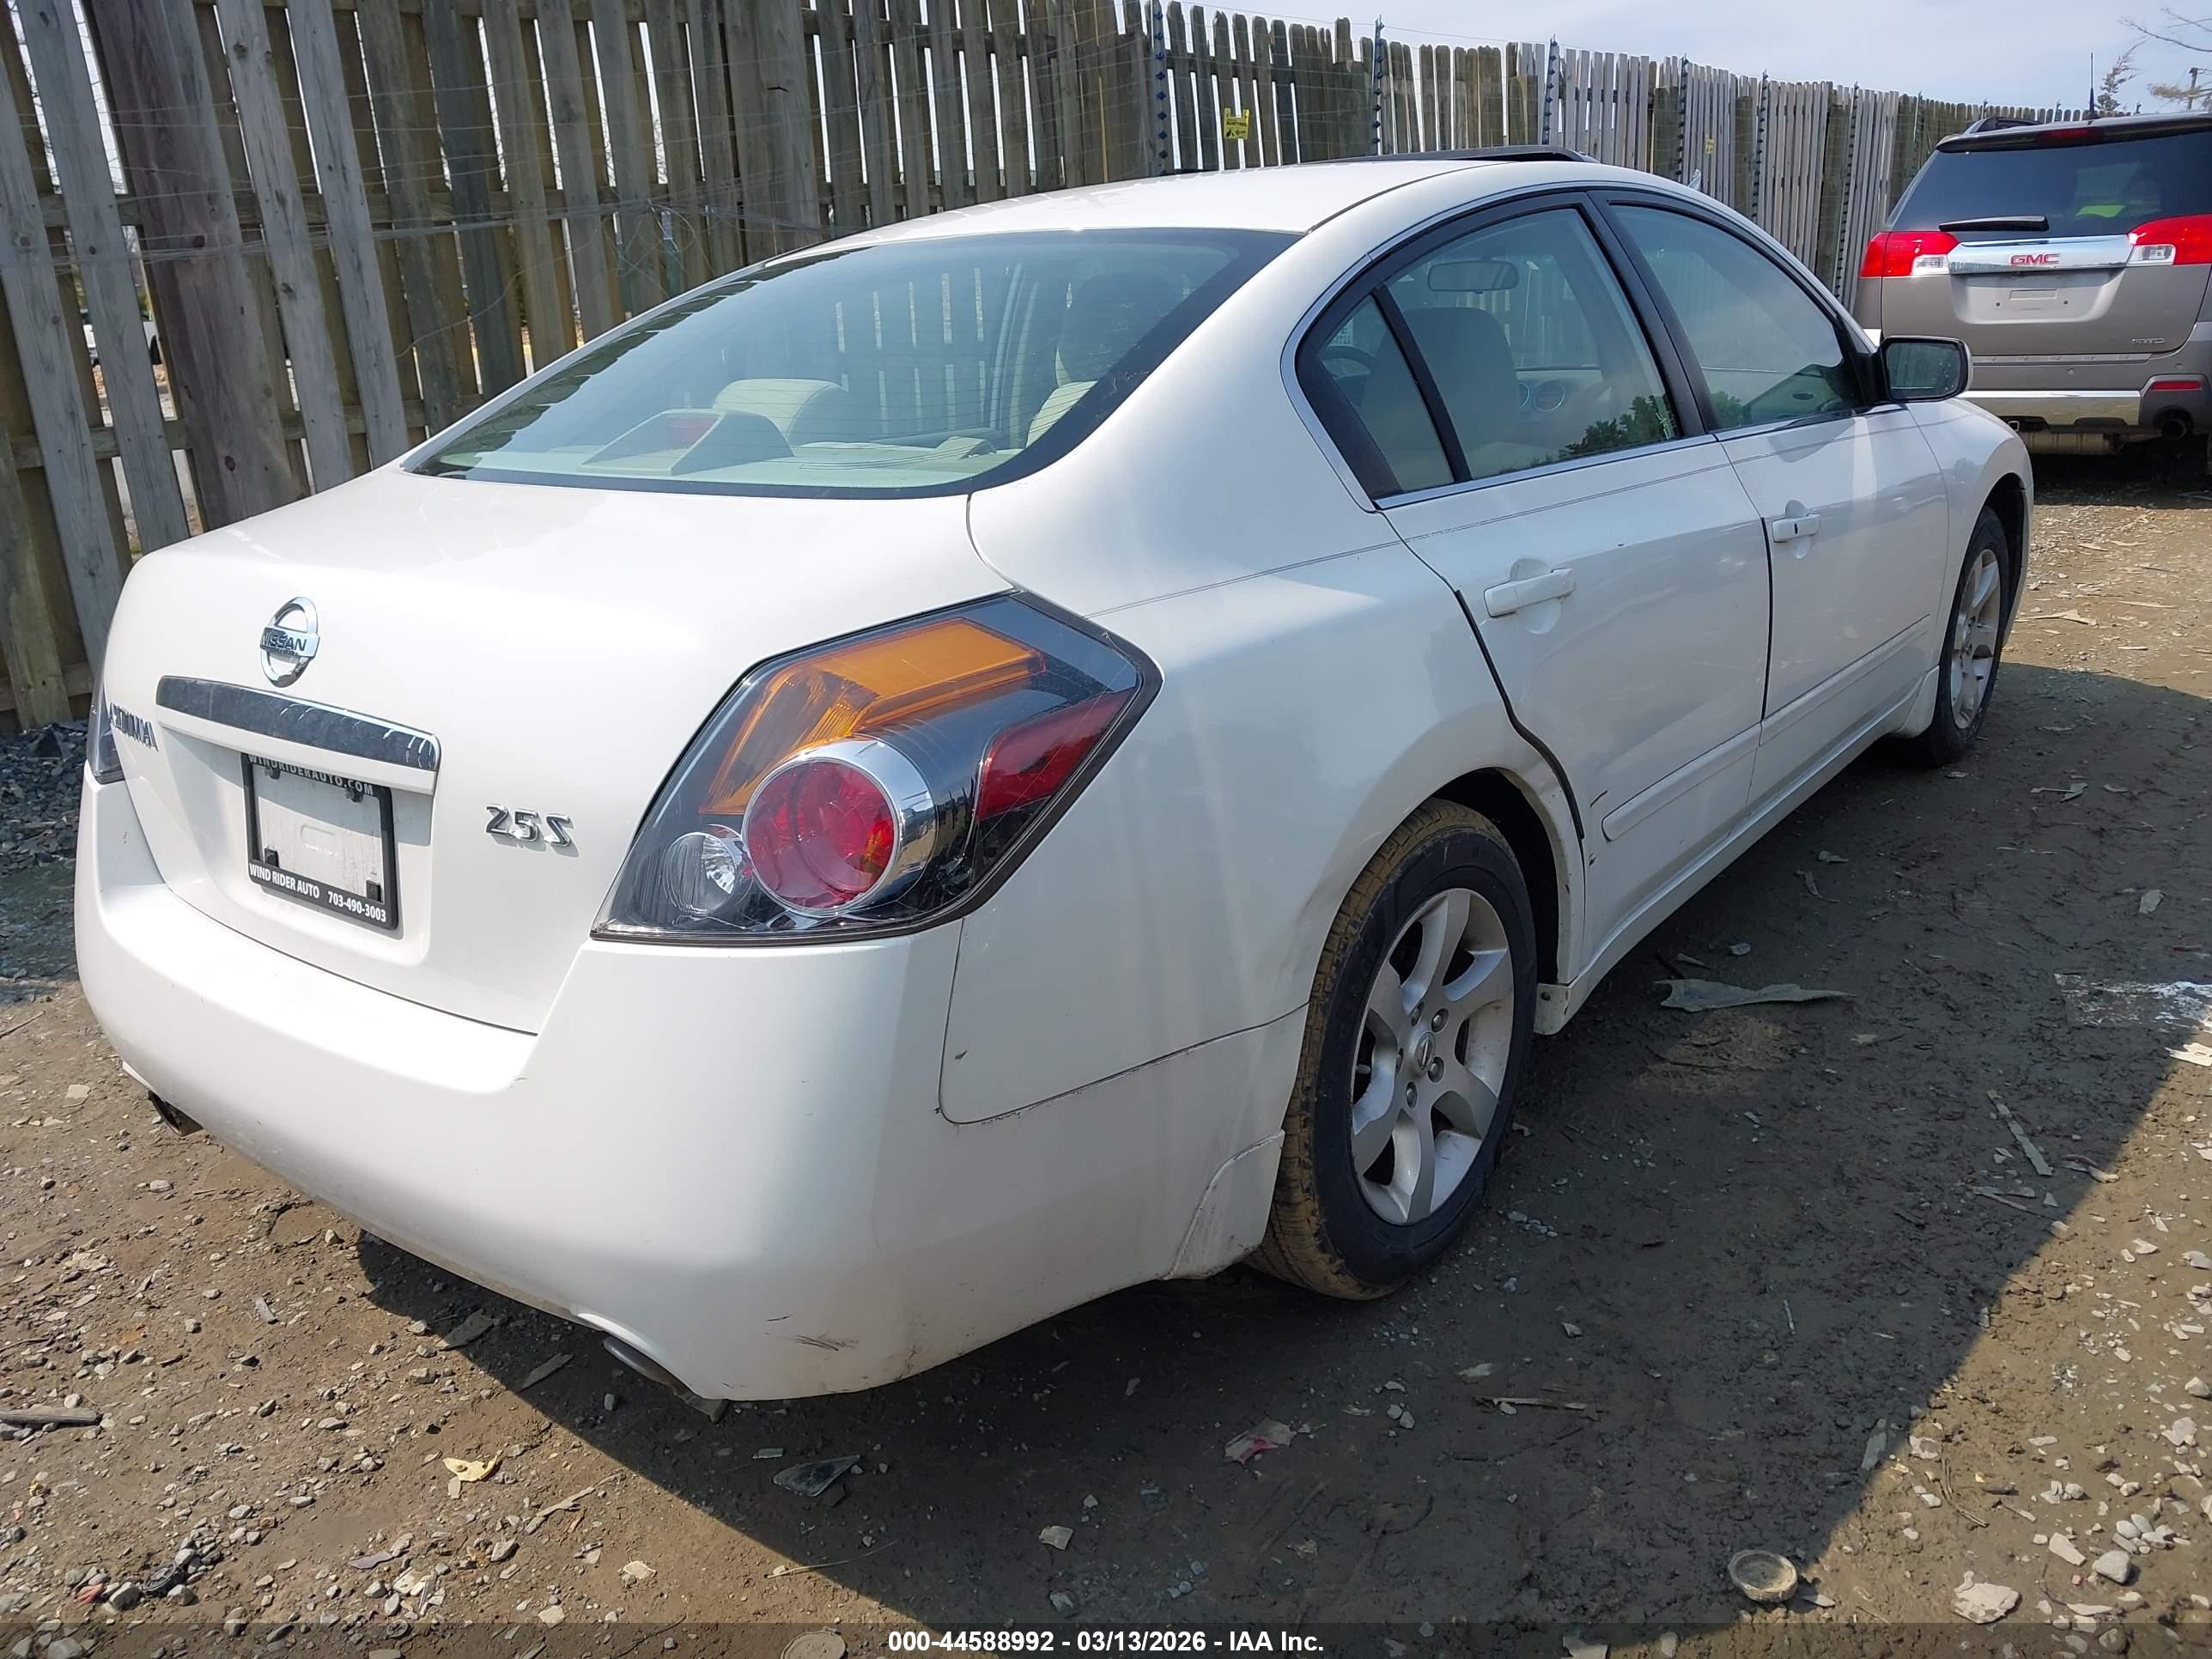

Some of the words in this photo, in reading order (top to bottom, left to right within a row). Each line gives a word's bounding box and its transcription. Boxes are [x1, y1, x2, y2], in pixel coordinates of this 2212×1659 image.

[2010, 253, 2061, 265] GMC
[262, 630, 307, 652] NISSAN
[249, 862, 271, 882] WIND
[271, 871, 296, 893] RIDER
[296, 880, 320, 899] AUTO
[327, 890, 386, 923] 703-490-3003
